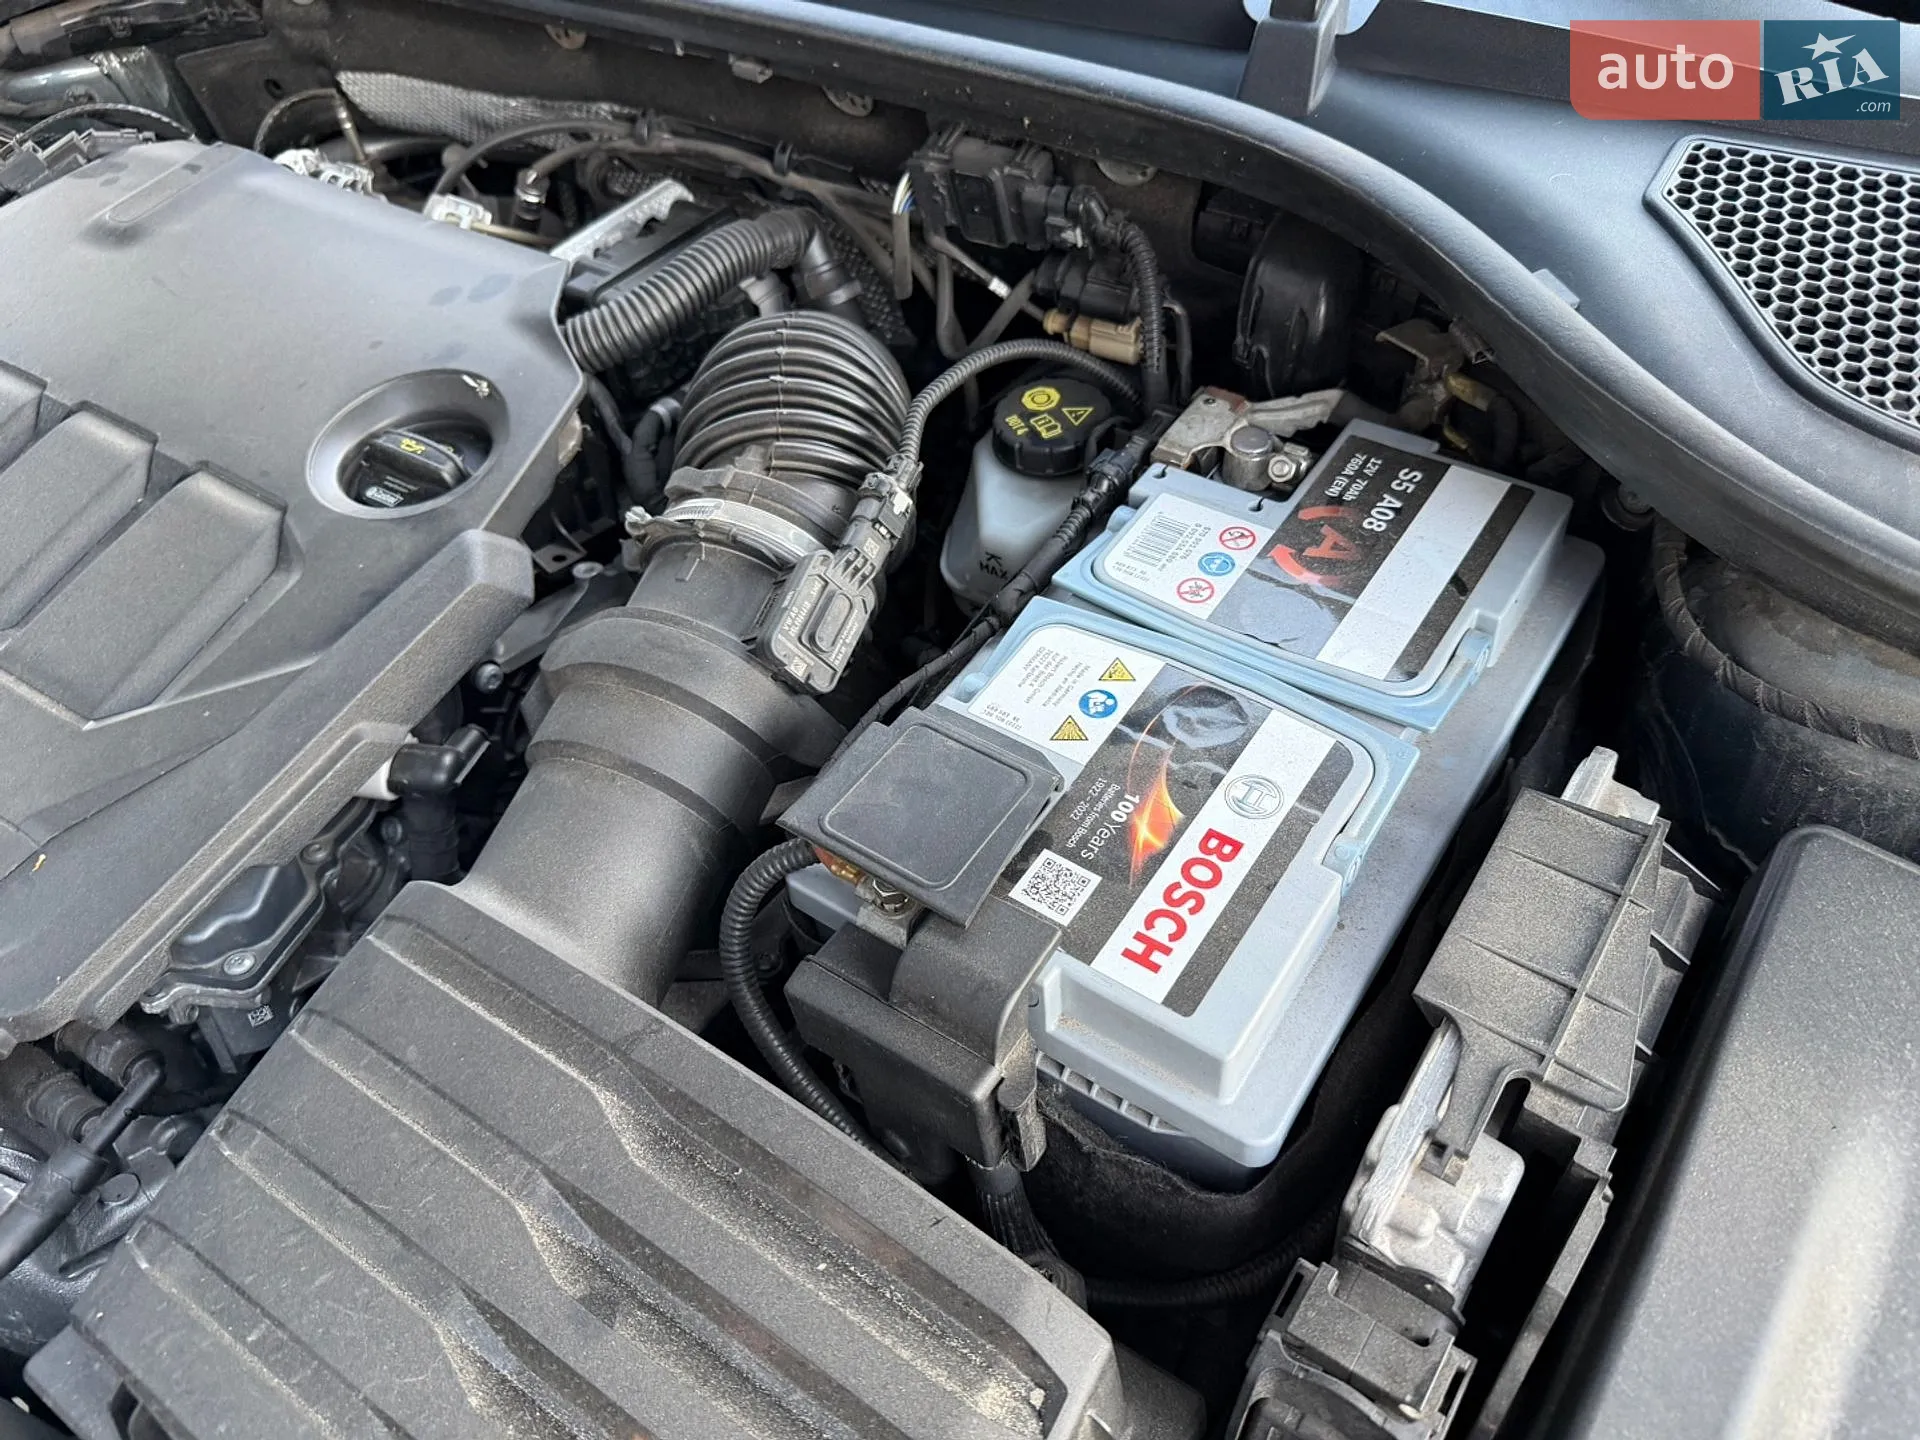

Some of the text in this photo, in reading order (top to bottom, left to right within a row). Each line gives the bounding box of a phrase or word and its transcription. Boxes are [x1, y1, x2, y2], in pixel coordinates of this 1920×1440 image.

[1005, 414, 1028, 436] DOT 4
[1323, 476, 1347, 497] (EN)
[1343, 457, 1382, 502] 12V 70Ah
[1363, 468, 1423, 532] S5 A08
[1075, 665, 1090, 679] Made
[1051, 684, 1074, 707] Germany
[1087, 776, 1107, 796] 1922
[1065, 782, 1120, 849] Batteries from Bosch
[1069, 800, 1089, 821] 2022
[1081, 793, 1140, 860] 100 Years
[1123, 829, 1243, 972] BOSCH
